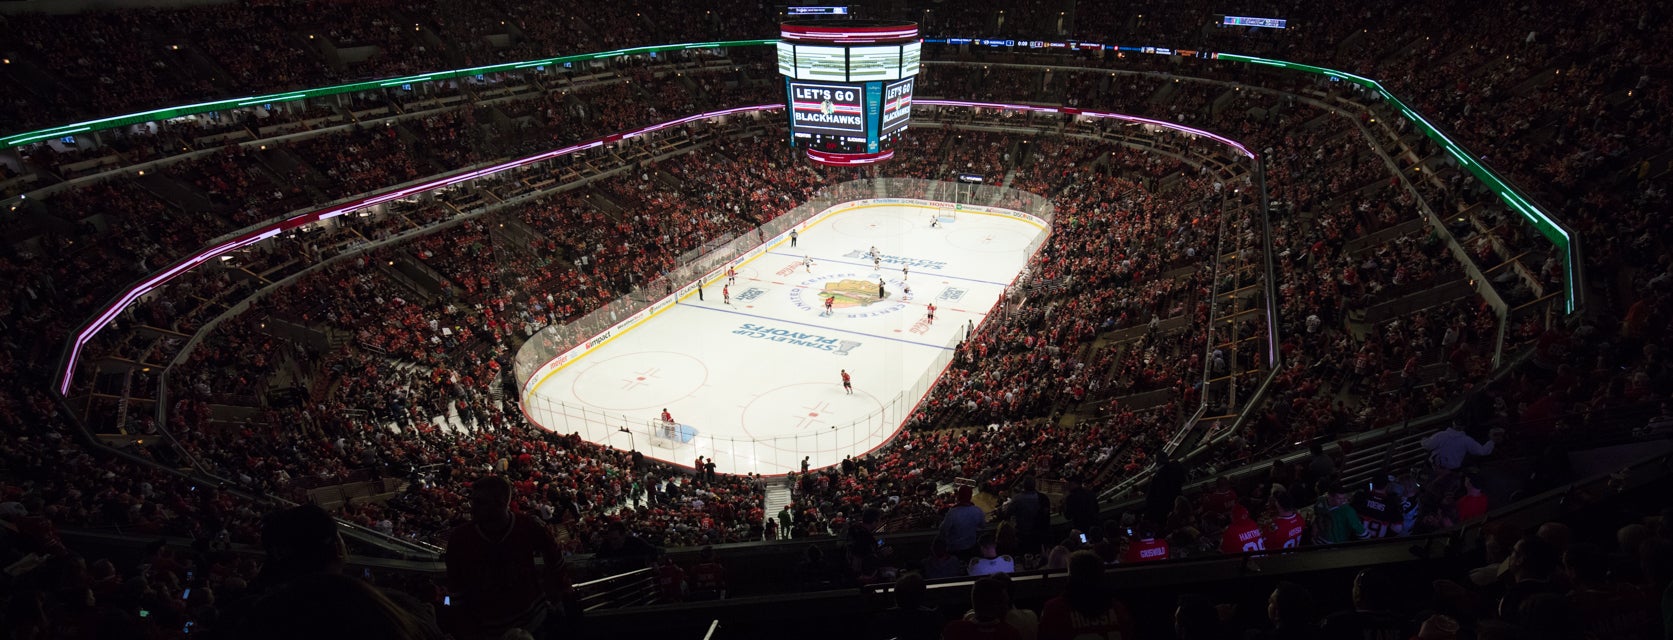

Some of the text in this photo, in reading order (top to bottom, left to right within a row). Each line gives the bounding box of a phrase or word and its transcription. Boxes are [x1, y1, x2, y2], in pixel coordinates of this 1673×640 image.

[796, 88, 854, 101] LET'S GO
[887, 86, 902, 100] LET'S
[903, 83, 911, 94] GO
[795, 112, 861, 125] BLACKHAWKS
[790, 273, 856, 312] UNITED CENTER
[847, 303, 906, 318] CENTER
[590, 331, 611, 347] impact
[732, 330, 838, 351] STANLEY CUP
[739, 323, 838, 344] PLAYOFFS
